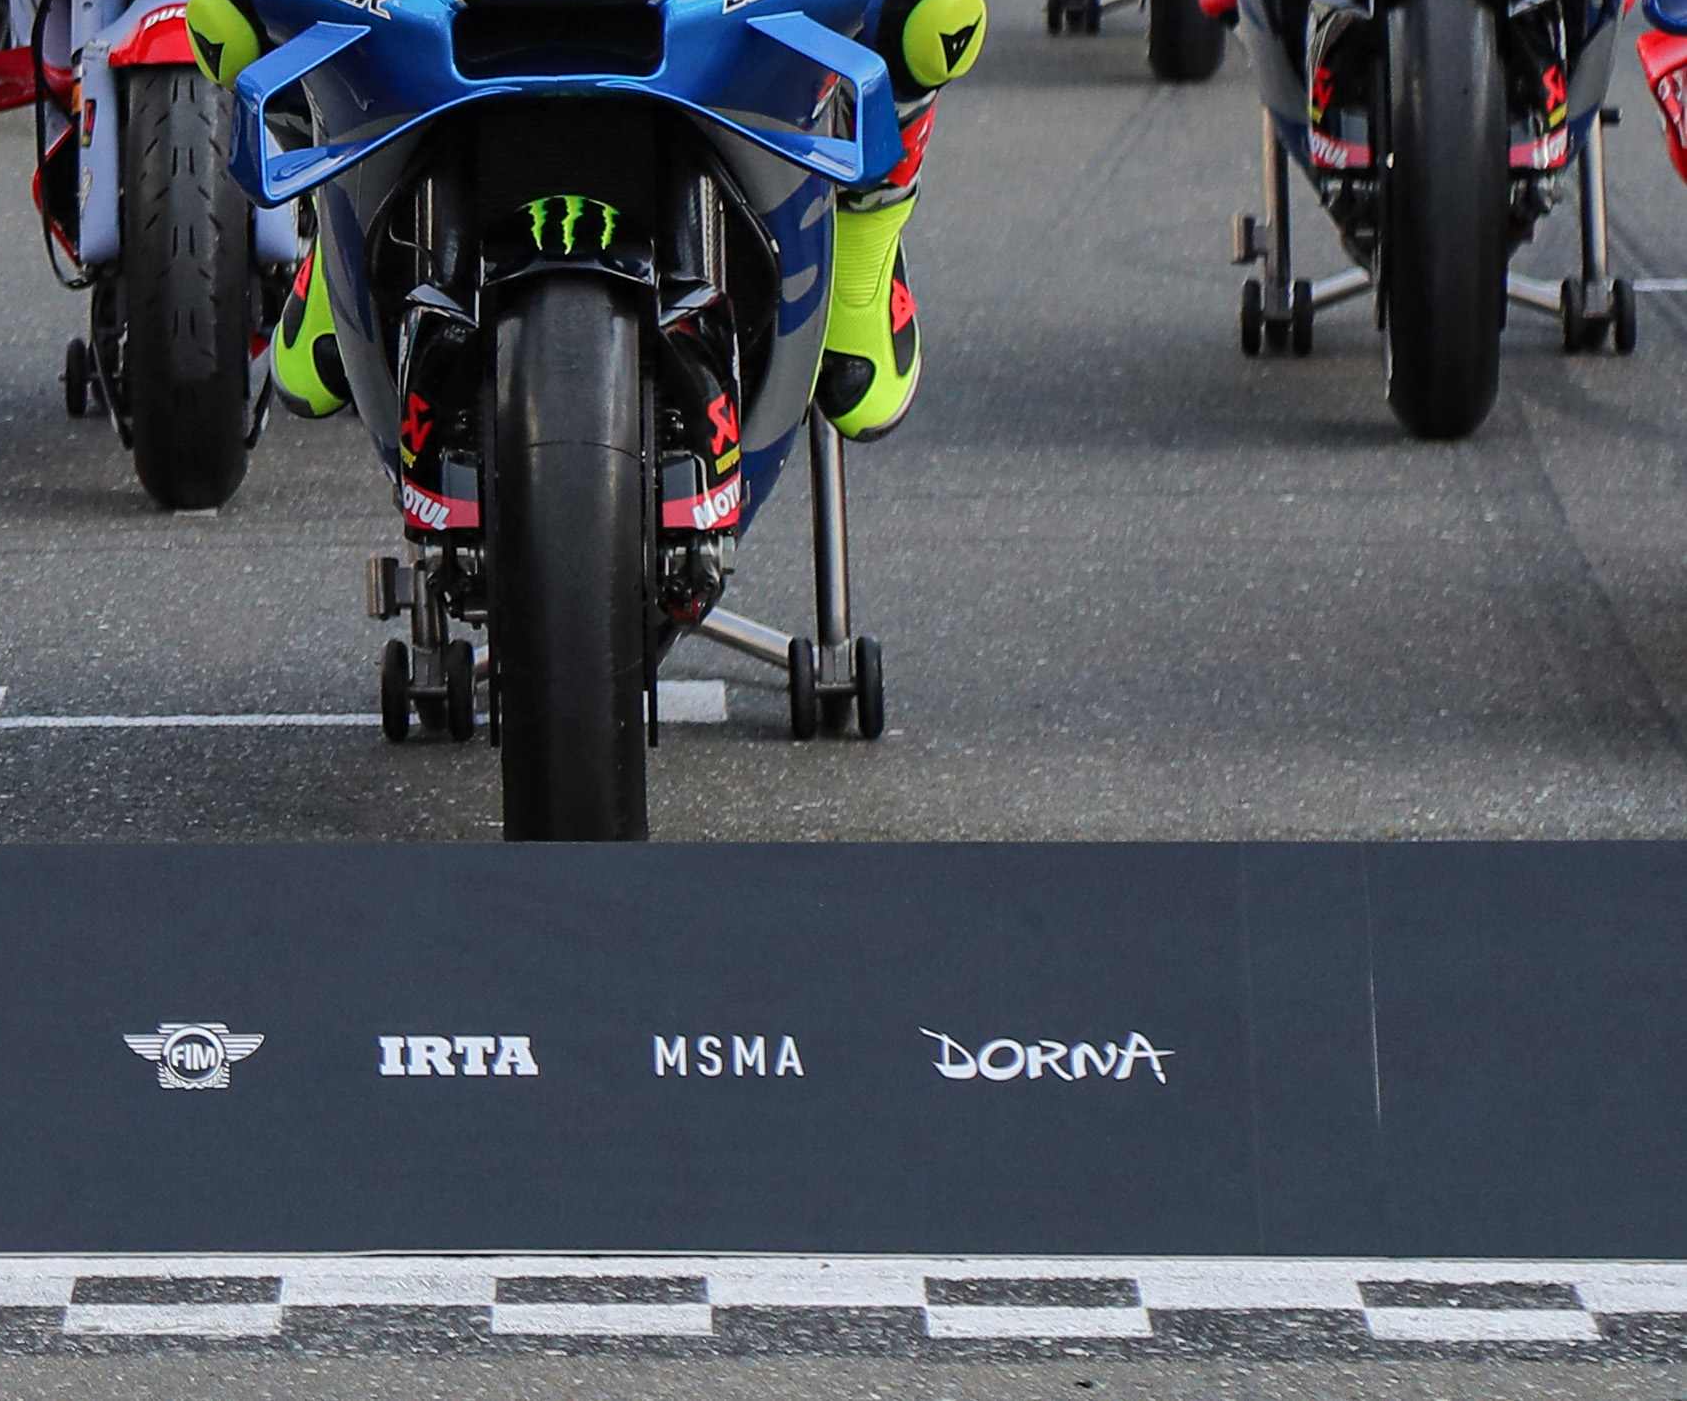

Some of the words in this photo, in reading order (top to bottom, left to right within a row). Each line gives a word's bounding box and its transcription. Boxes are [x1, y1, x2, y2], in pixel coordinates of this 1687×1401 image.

[171, 1041, 218, 1073] FIM
[377, 1034, 539, 1077] IRTA
[654, 1034, 806, 1078] MSMA
[919, 1027, 1177, 1085] DORNA
